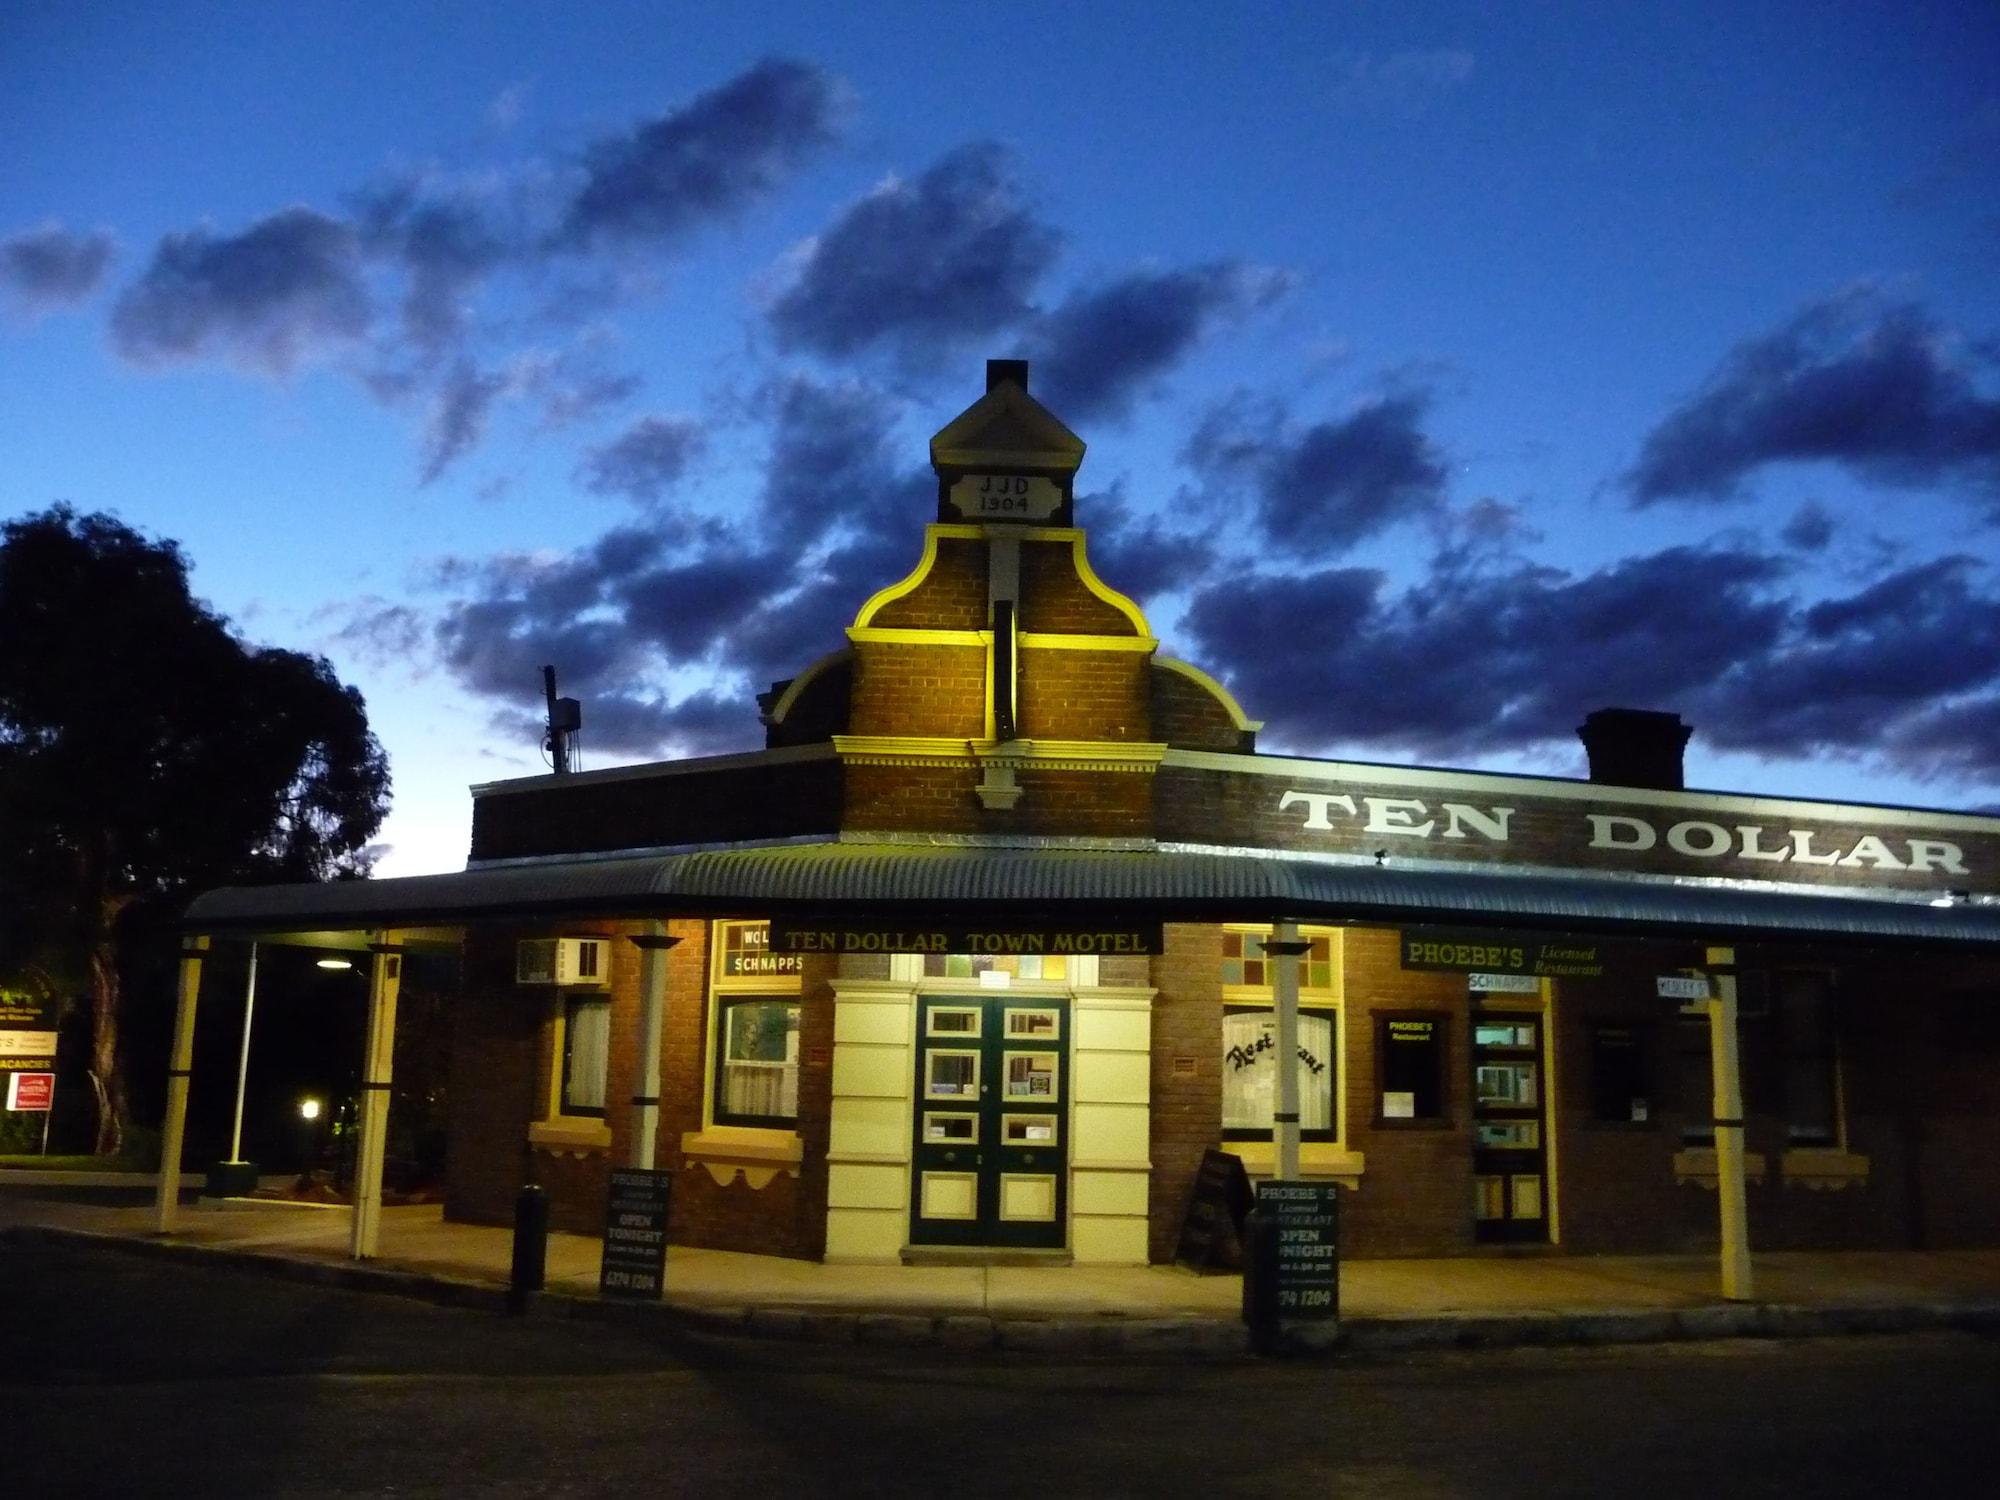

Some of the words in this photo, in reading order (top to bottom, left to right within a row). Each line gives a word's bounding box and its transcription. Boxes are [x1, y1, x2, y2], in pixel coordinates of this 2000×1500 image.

[1278, 790, 1515, 841] TEN
[1586, 814, 1971, 875] DOLLAR
[784, 931, 836, 950] TEN
[844, 931, 948, 952] DOLLAR
[966, 932, 1044, 951] TOWN
[1051, 933, 1148, 952] MOTEL
[1407, 943, 1525, 968] PHOEBE'S
[1539, 945, 1597, 961] Licensed
[734, 957, 804, 971] SCHNAPPS
[0, 1060, 51, 1069] ACANCIES
[608, 1227, 664, 1243] TONIGHT
